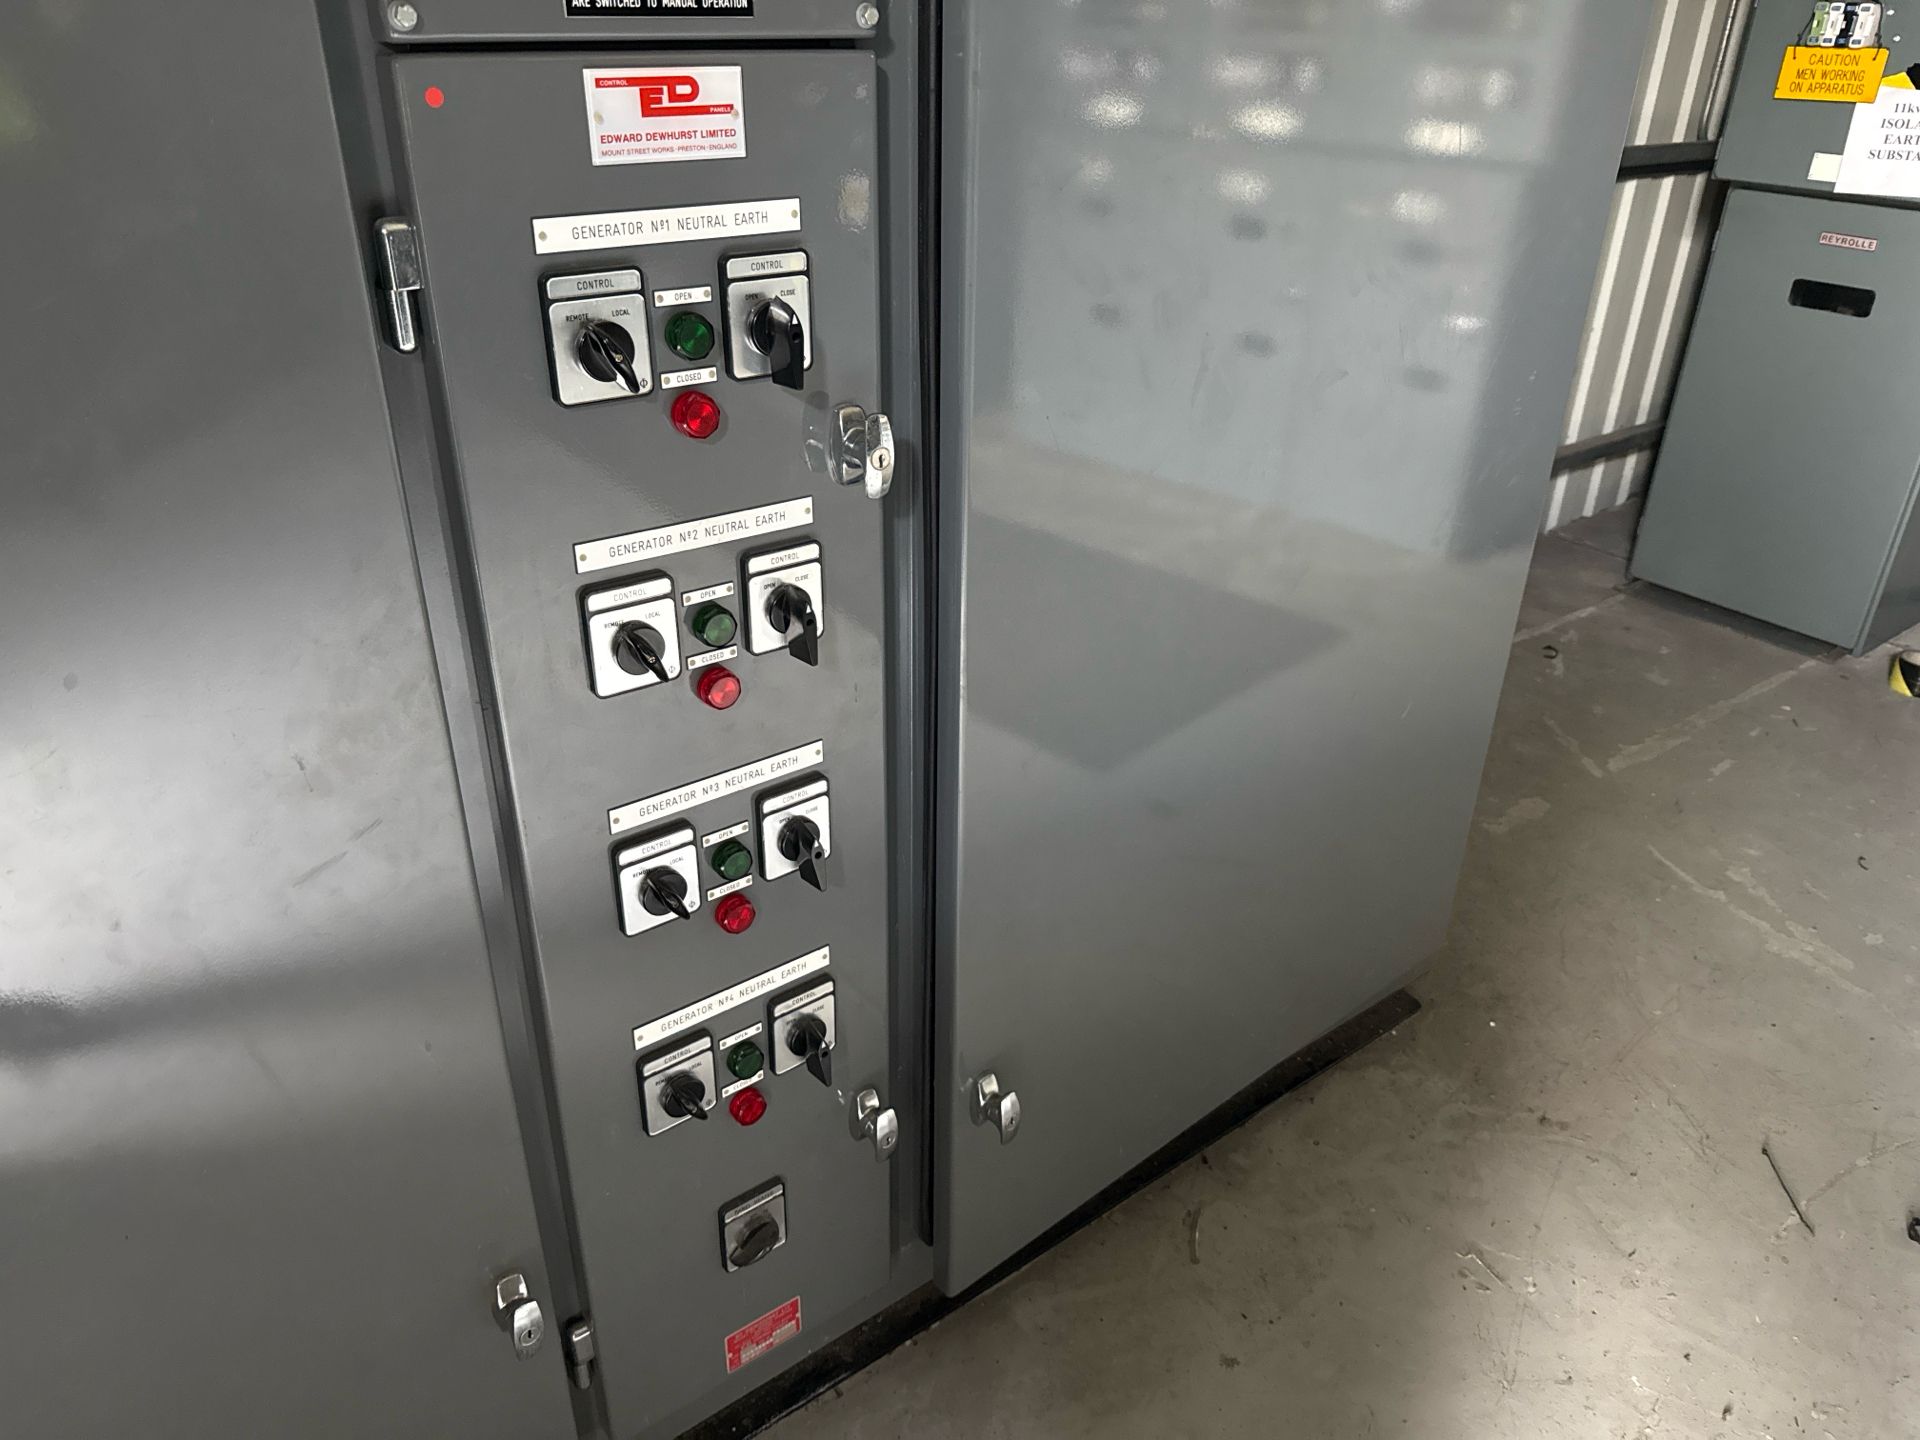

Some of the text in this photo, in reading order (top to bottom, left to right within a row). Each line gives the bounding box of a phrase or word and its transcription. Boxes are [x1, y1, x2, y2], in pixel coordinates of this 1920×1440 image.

[662, 0, 698, 8] MANUAL
[702, 0, 748, 8] OPERATION
[1808, 53, 1861, 67] CAUTION
[1795, 68, 1865, 82] MEN WORKING
[599, 79, 628, 87] CONTROL
[1789, 81, 1865, 96] ON APPARATUS
[600, 128, 737, 145] EDWARD DEWHURST LIMITED
[601, 148, 625, 157] MOUNT
[627, 147, 650, 156] STREET
[709, 142, 737, 151] ENGLAND
[571, 220, 644, 241] GENERATOR
[677, 214, 727, 231] NEUTRAL
[734, 211, 769, 226] EARTH
[1821, 234, 1874, 249] REYROLLE
[750, 259, 784, 271] CONTROL
[576, 278, 615, 291] CONTROL
[674, 291, 693, 301] OPEN
[780, 288, 796, 297] CLOSE
[565, 308, 630, 323] REMOTE LOCAL
[676, 372, 702, 383] CLOSED
[608, 534, 673, 558] GENERATOR
[704, 519, 750, 538] NEUTRAL
[755, 511, 786, 527] EARTH
[770, 551, 800, 566] CONTROL
[613, 586, 648, 602] CONTROL
[700, 588, 717, 599] OPEN
[639, 789, 697, 817] GENERATOR
[725, 768, 766, 789] NEUTRAL
[770, 755, 799, 772] EARTH
[660, 1003, 714, 1032] GENERATOR
[739, 976, 776, 997] NEUTRAL
[781, 962, 807, 979] EARTH
